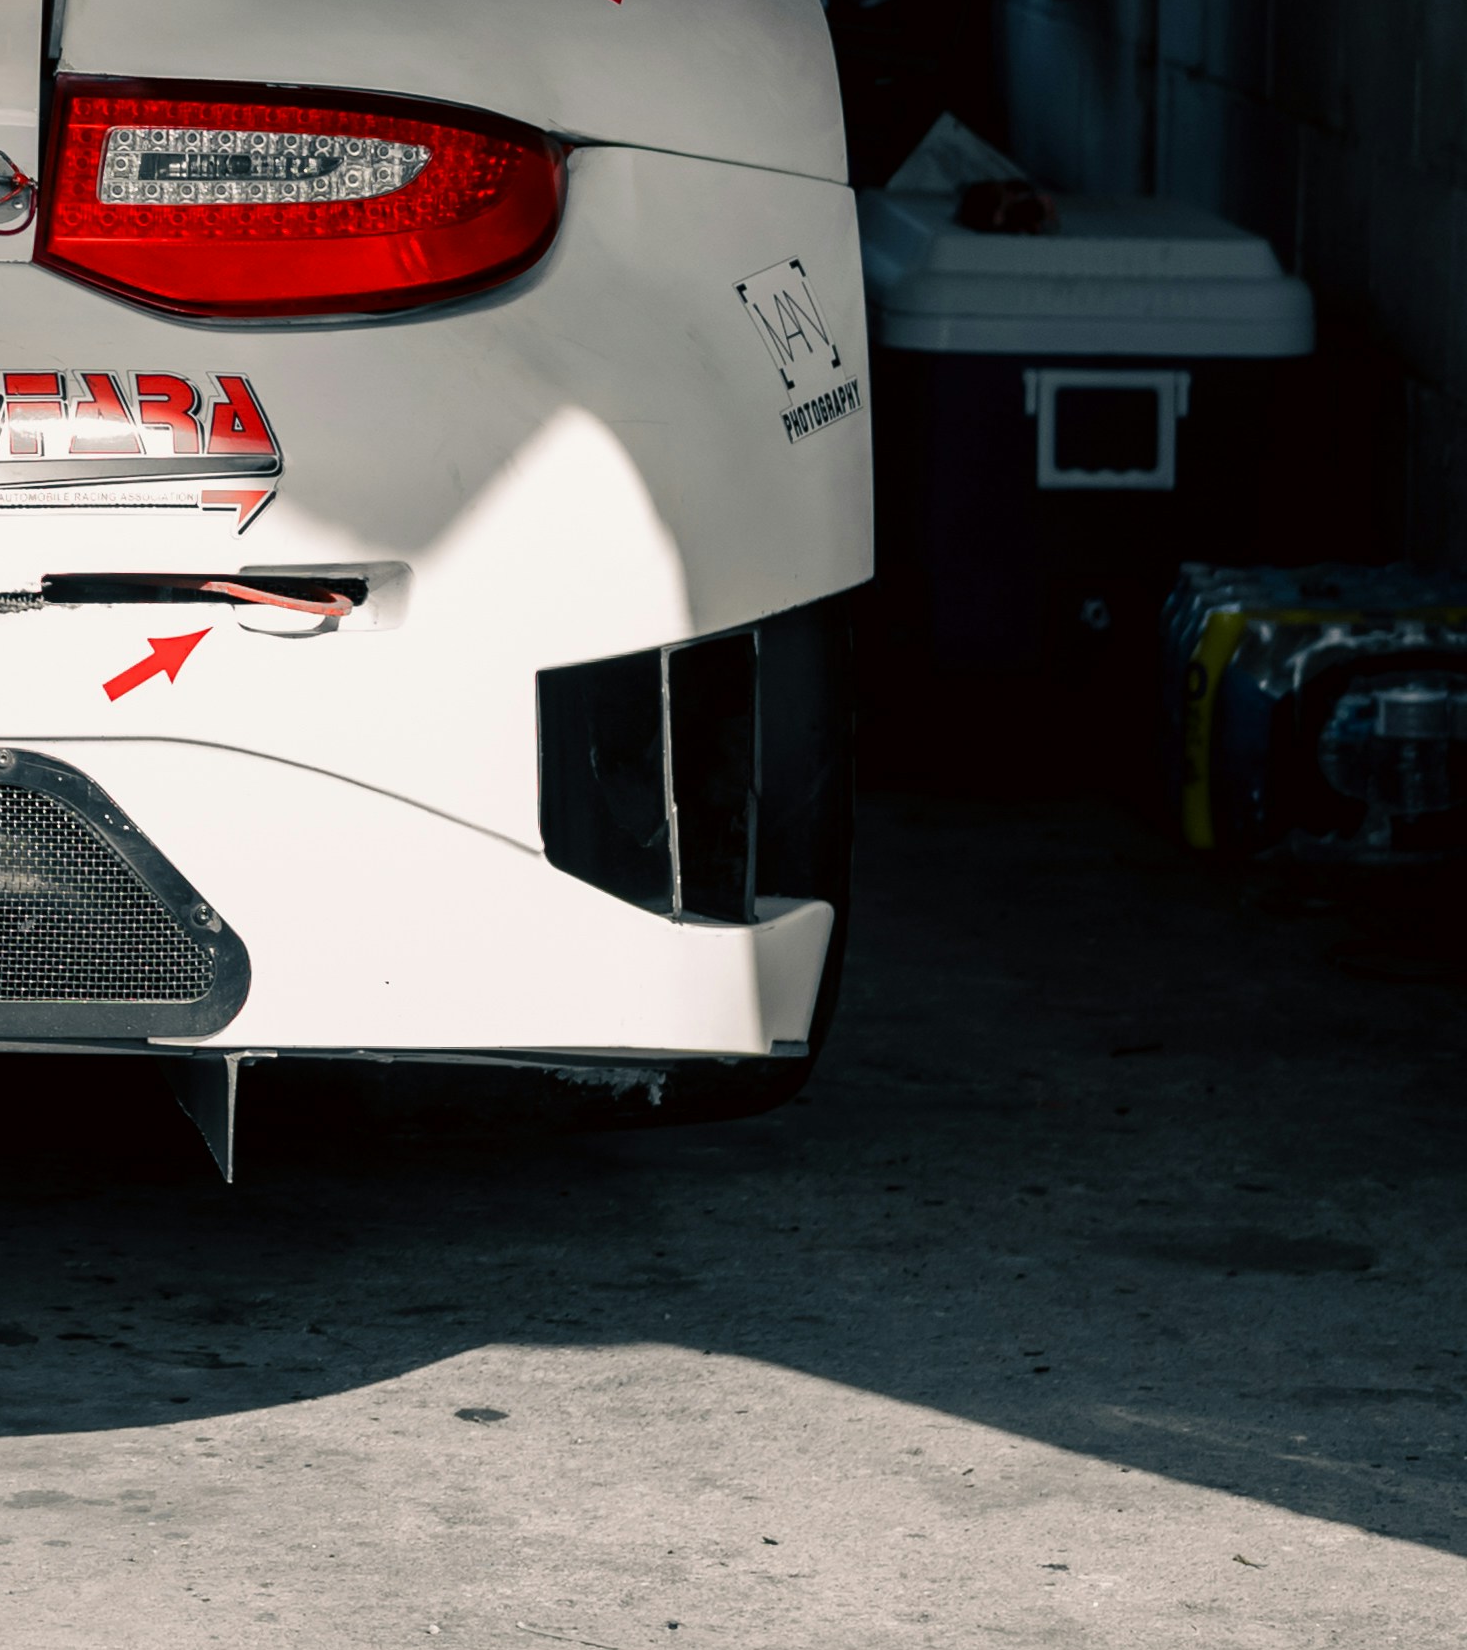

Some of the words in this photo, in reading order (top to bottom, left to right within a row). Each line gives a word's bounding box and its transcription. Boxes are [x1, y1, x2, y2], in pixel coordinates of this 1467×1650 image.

[2, 371, 277, 455] FARA
[781, 379, 862, 444] PHOTOGRAPHY
[74, 492, 116, 502] RACING
[120, 492, 195, 502] ASSOCIATION
